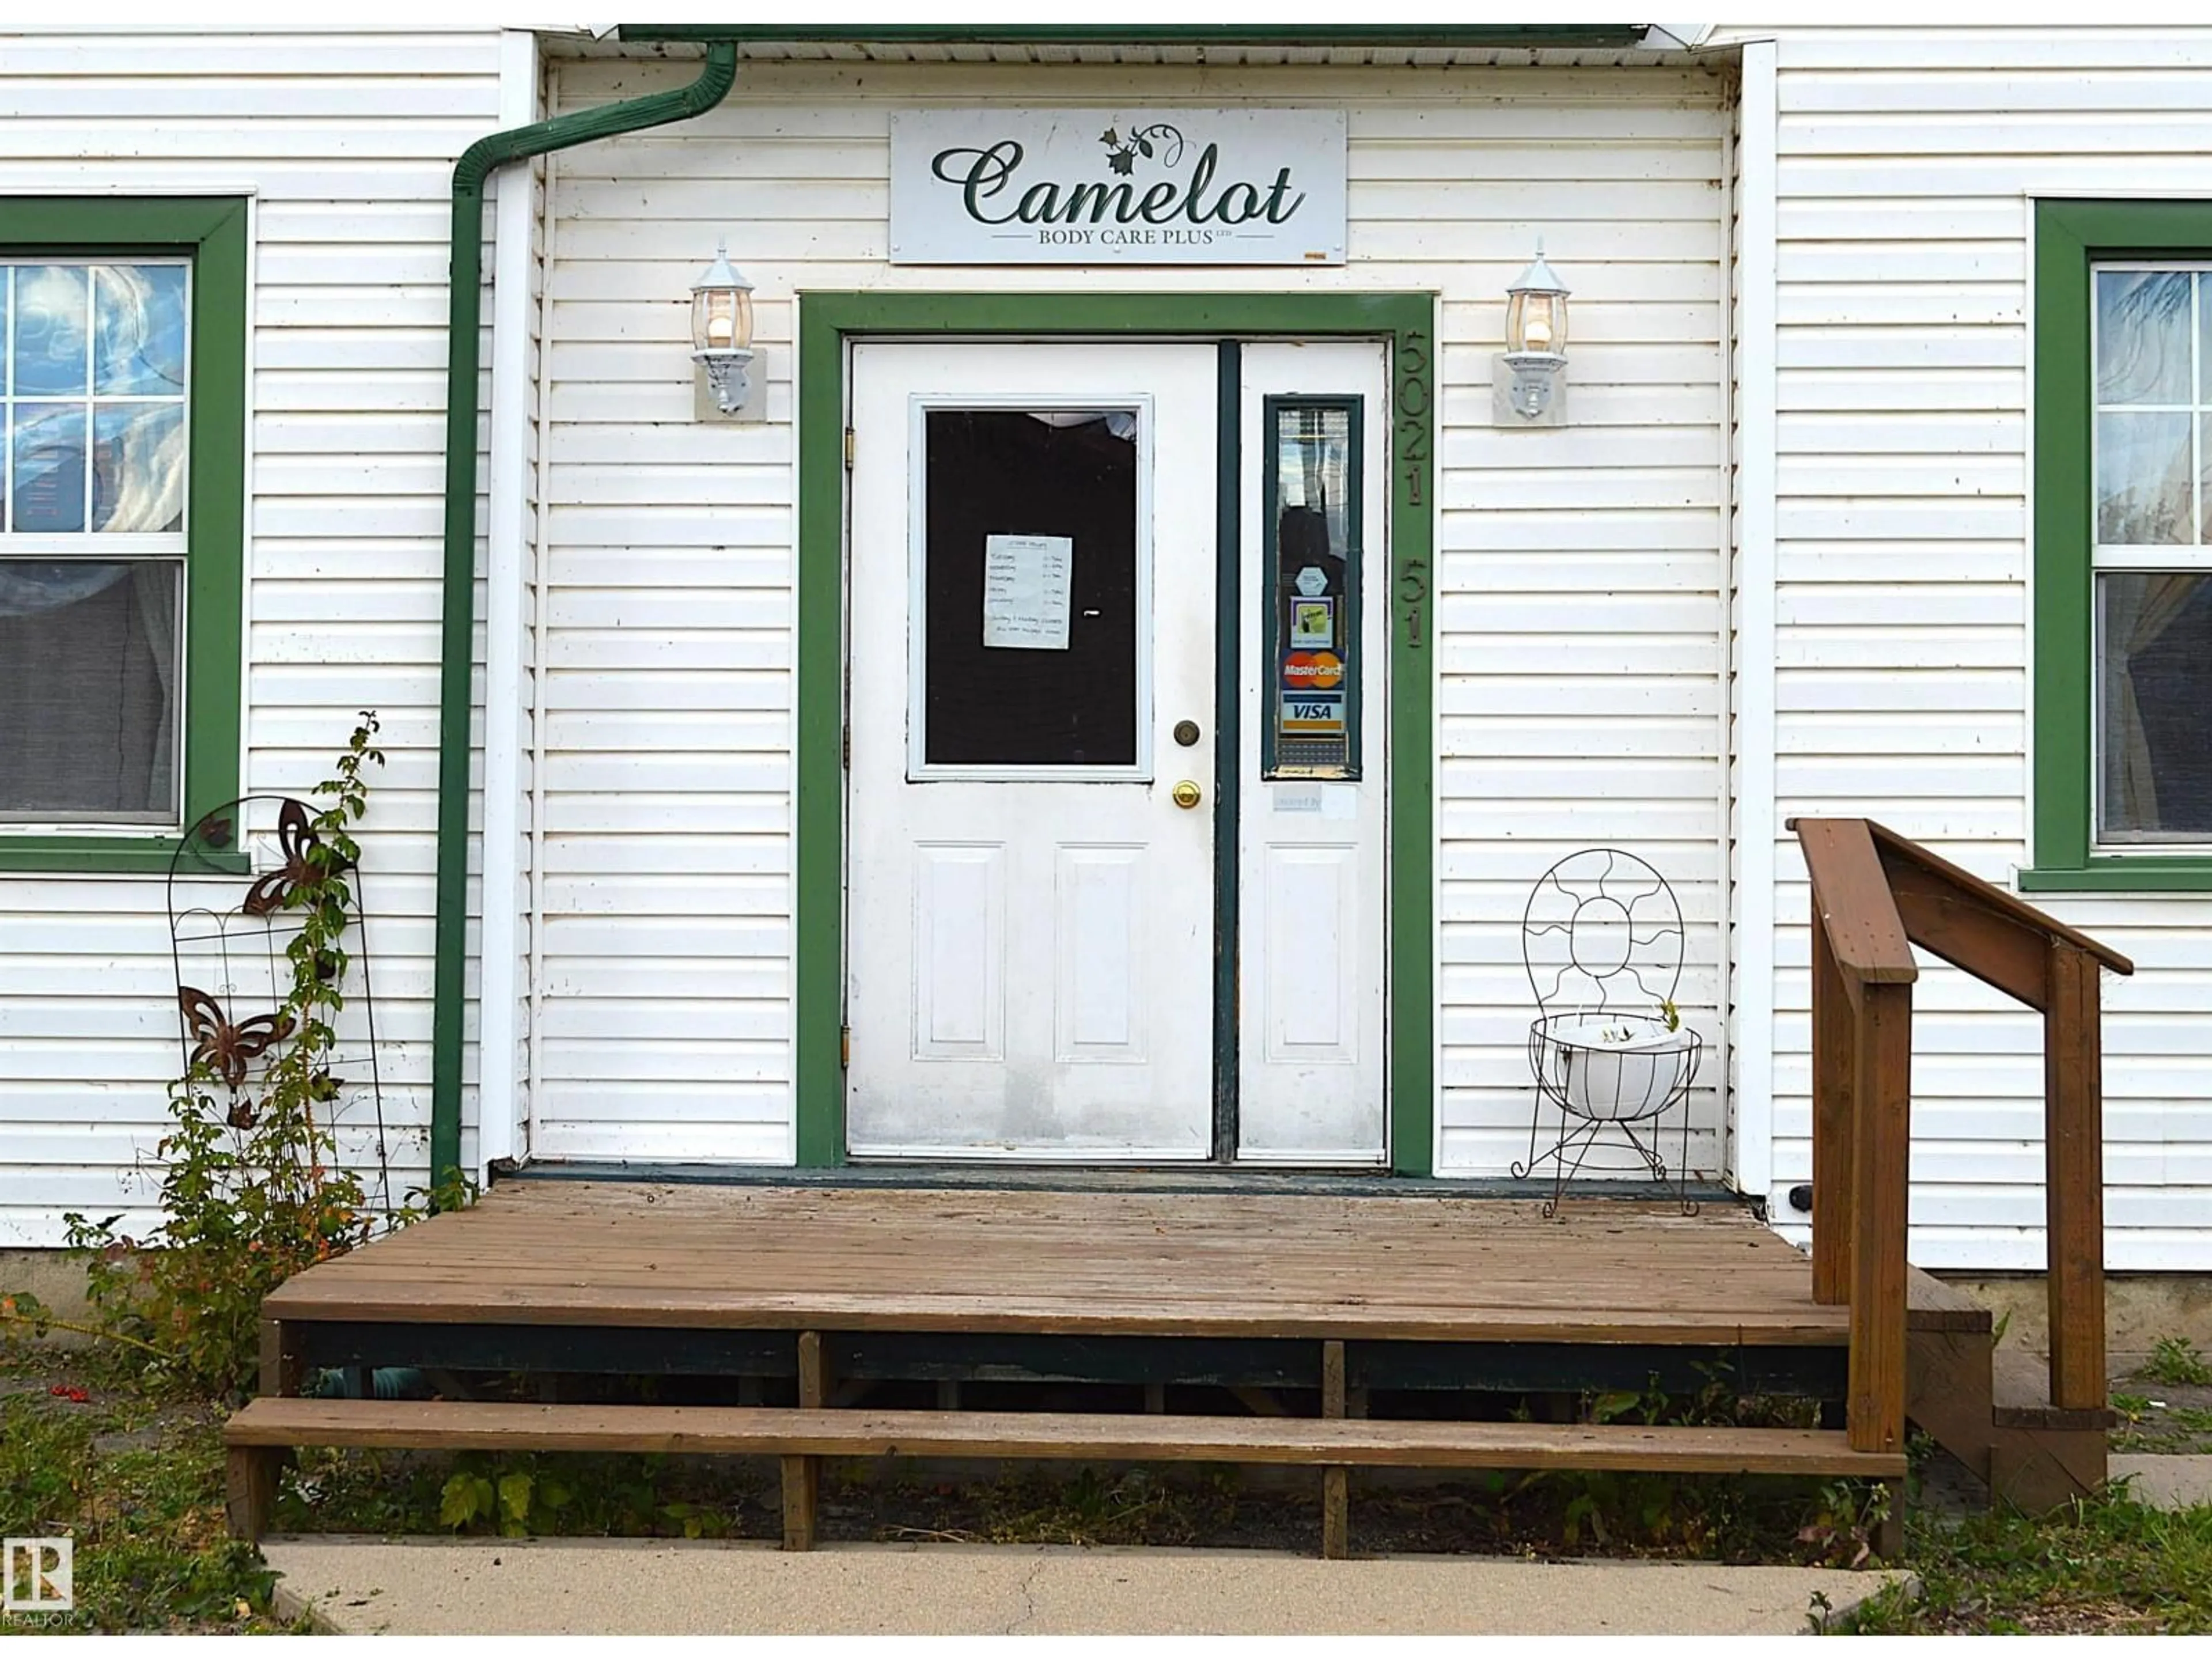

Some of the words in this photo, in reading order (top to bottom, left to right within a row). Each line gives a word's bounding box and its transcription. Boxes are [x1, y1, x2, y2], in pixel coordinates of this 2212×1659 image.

[931, 141, 1306, 225] Camelot
[1039, 230, 1093, 244] BODY
[1100, 230, 1156, 244] CARE
[1162, 230, 1212, 244] PLUS
[1398, 331, 1429, 506] 5021
[1400, 559, 1427, 648] 51
[1284, 662, 1342, 676] MasterCard
[1294, 705, 1331, 719] VISA
